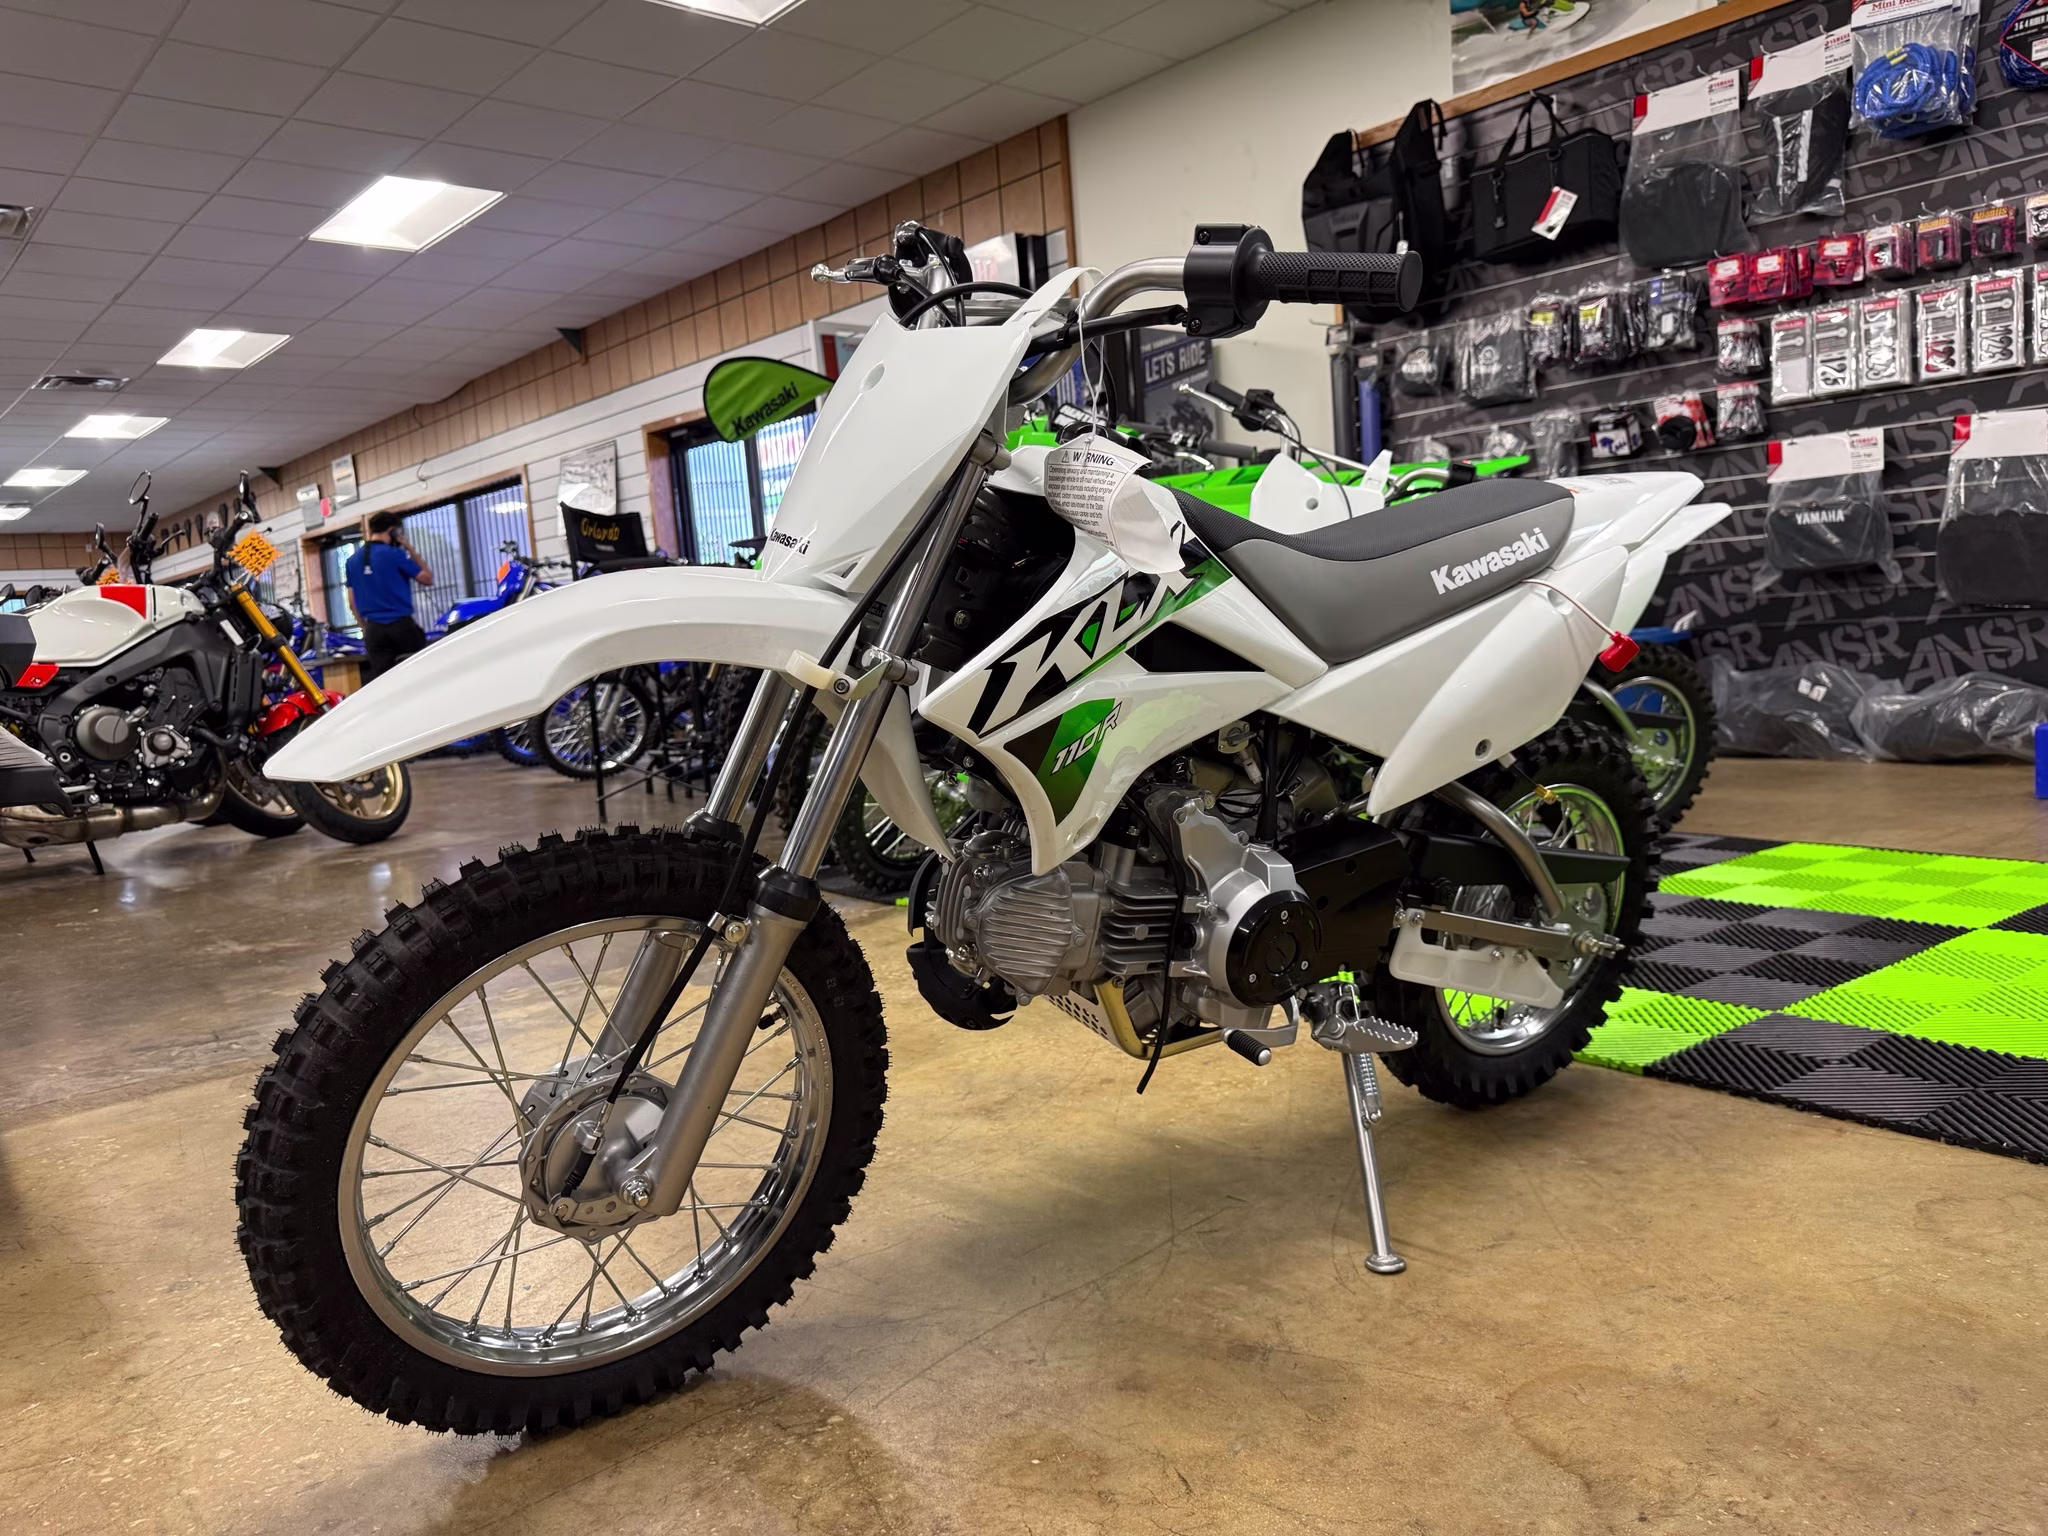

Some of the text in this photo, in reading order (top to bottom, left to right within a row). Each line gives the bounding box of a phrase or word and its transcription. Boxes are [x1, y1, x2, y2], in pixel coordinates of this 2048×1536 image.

[1179, 340, 1206, 372] RIDE
[731, 381, 800, 438] Kawasaki
[1072, 451, 1115, 466] WRNING
[1795, 508, 1846, 526] YAMAHA
[768, 527, 811, 556] Kawasaki
[1430, 527, 1550, 596] Kawasaki
[1051, 700, 1123, 777] 110R
